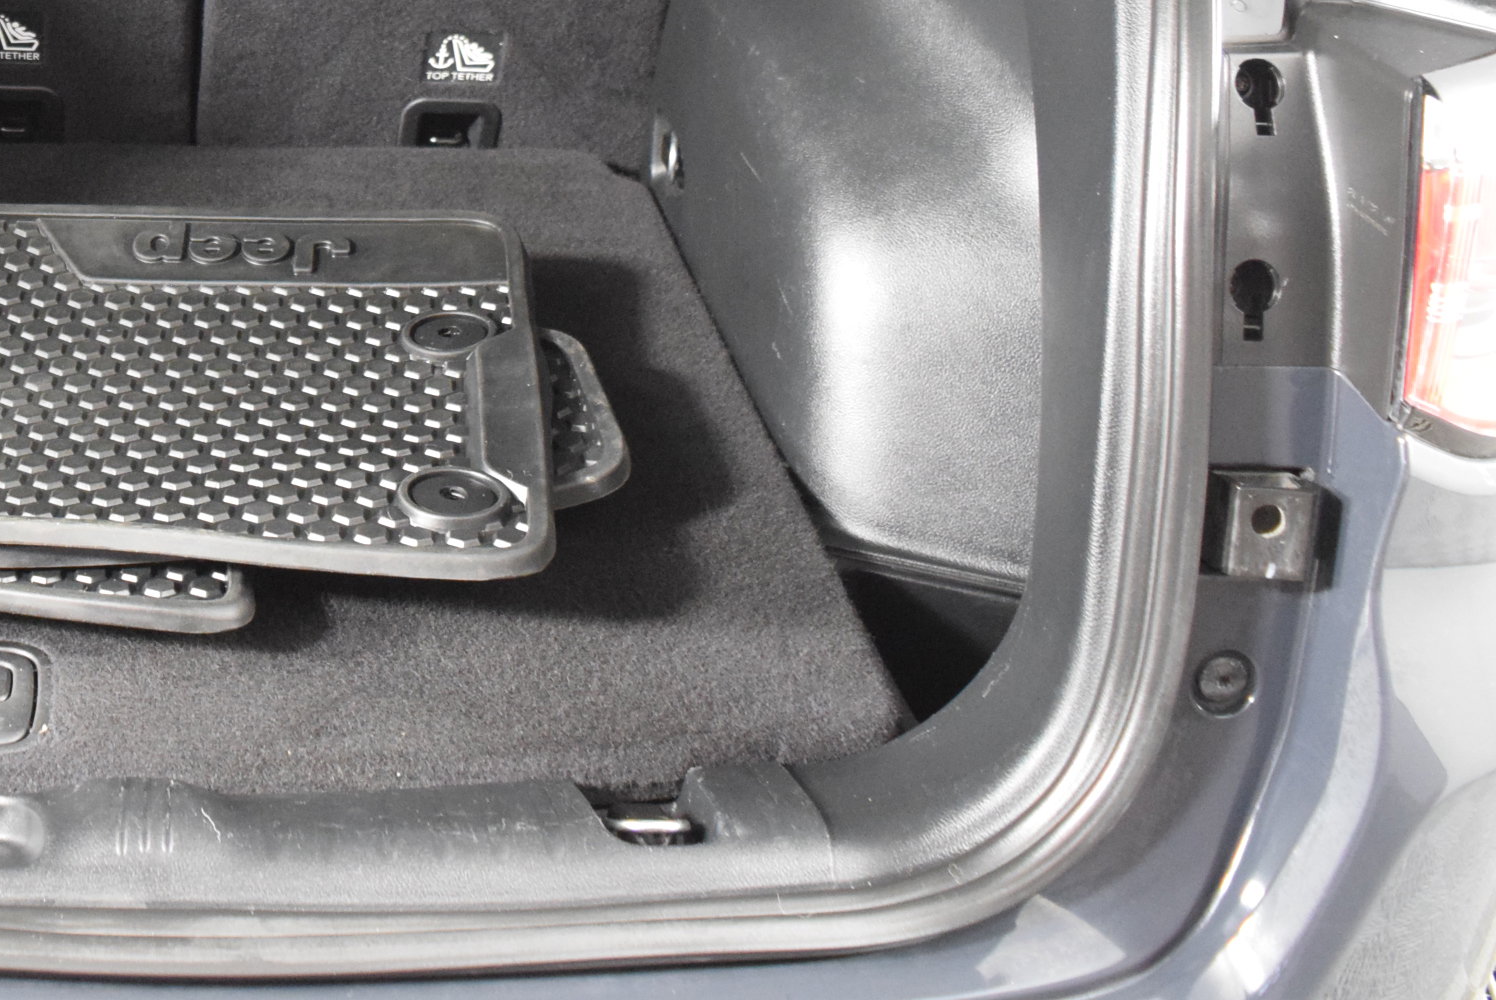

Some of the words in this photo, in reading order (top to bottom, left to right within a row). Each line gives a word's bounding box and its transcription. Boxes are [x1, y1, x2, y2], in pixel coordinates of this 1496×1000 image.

[426, 71, 449, 81] TOP
[451, 71, 494, 82] TETHER
[132, 220, 354, 275] Jeep
